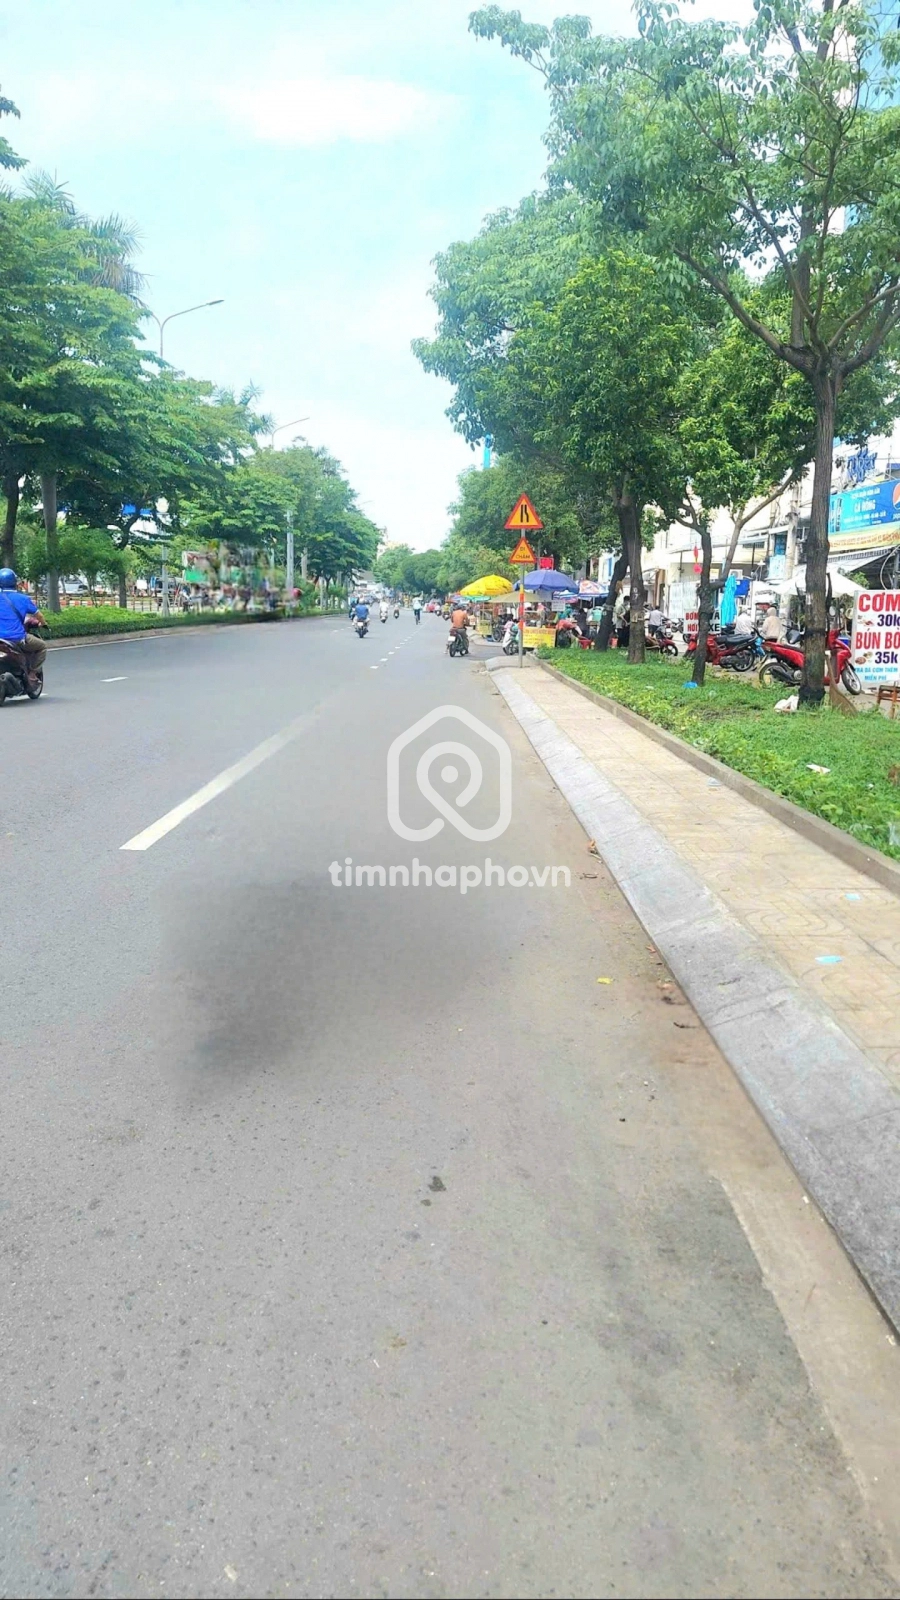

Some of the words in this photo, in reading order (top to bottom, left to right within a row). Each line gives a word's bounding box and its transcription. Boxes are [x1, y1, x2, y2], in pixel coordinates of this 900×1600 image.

[858, 592, 900, 612] CƠM
[855, 628, 881, 650] BÚN
[874, 651, 898, 664] 35k
